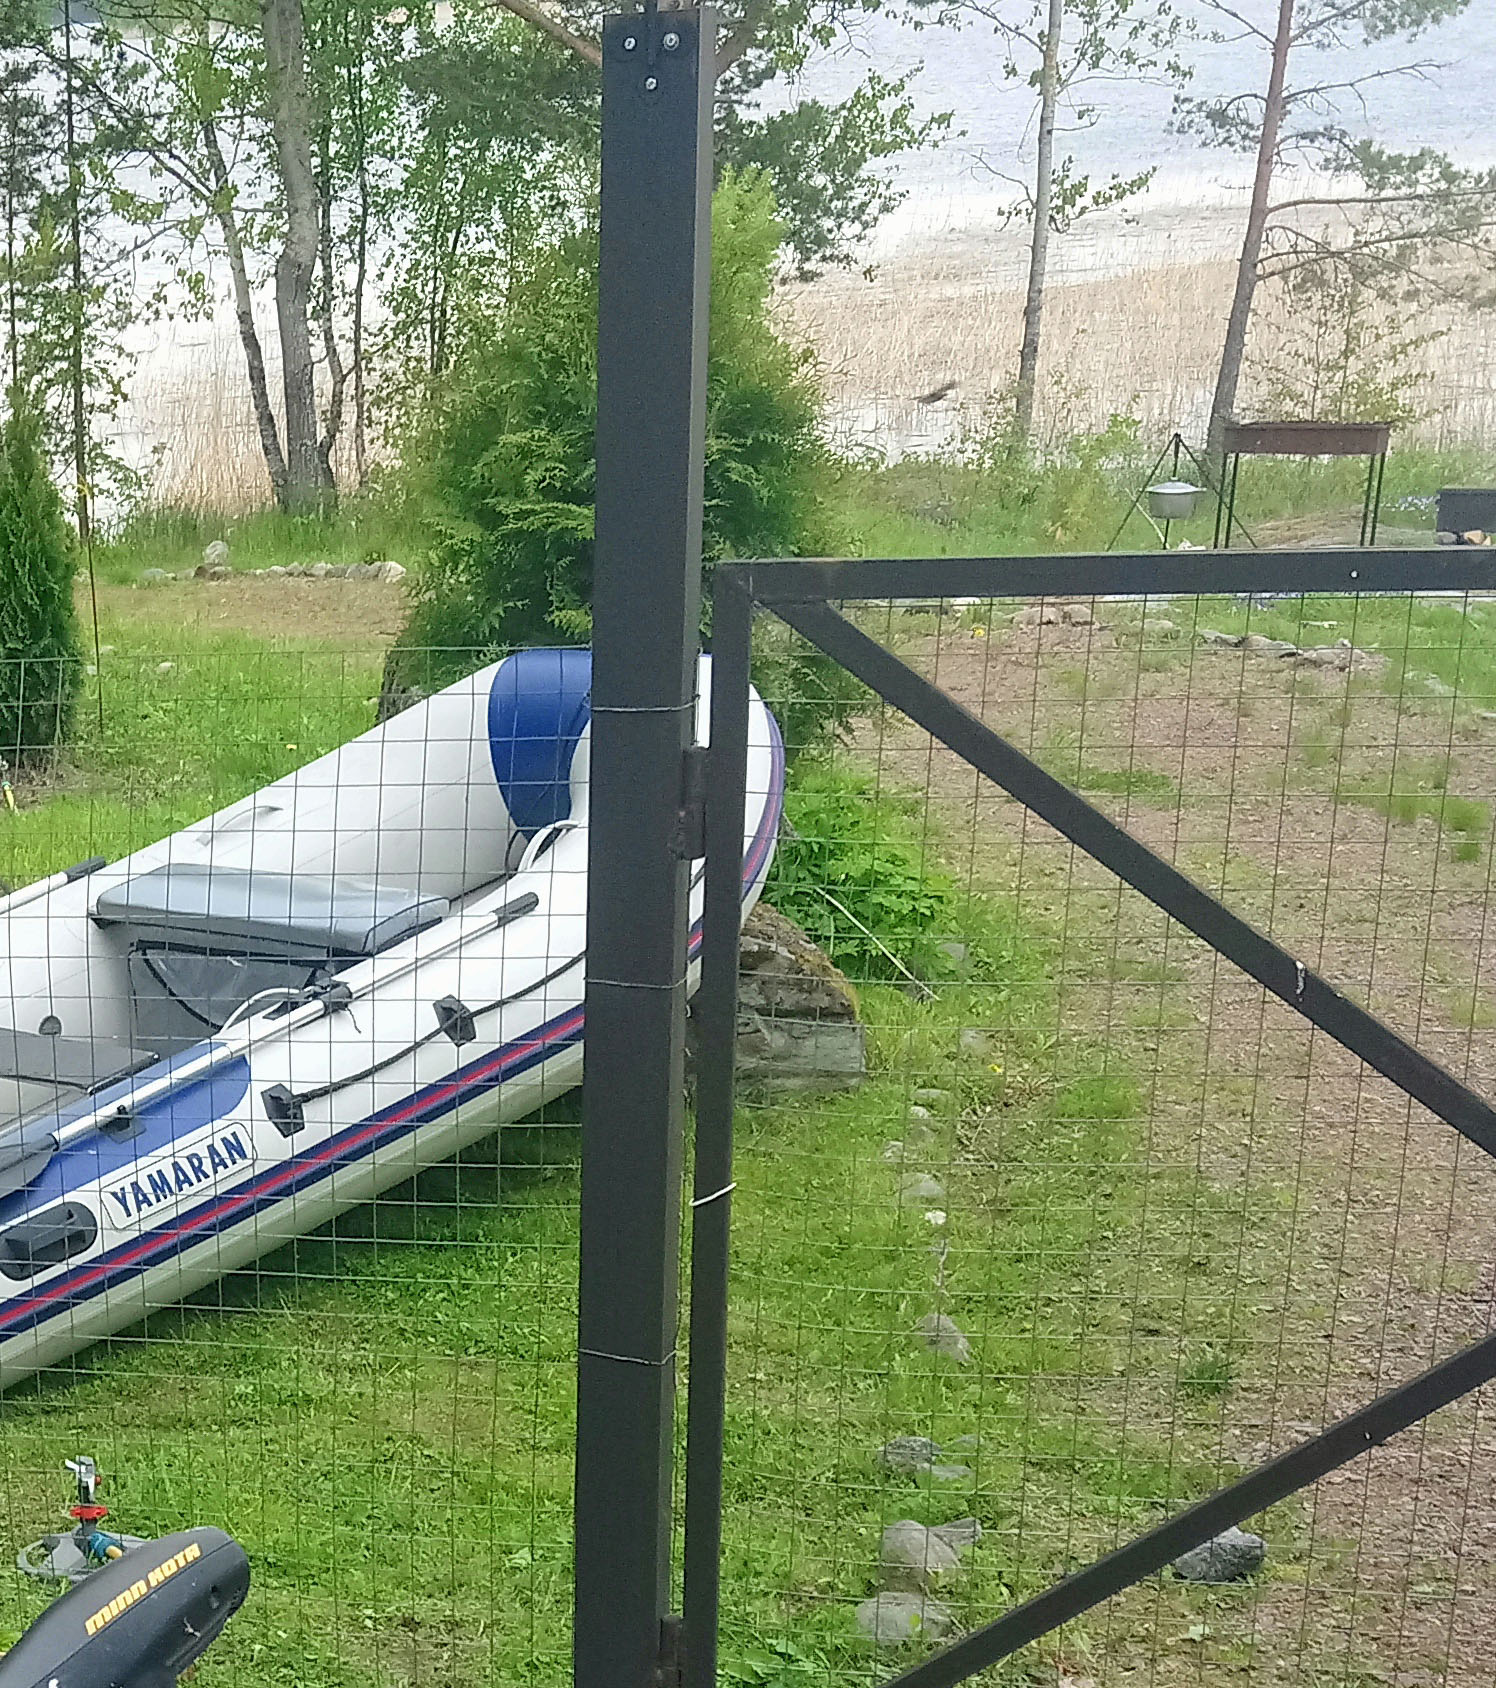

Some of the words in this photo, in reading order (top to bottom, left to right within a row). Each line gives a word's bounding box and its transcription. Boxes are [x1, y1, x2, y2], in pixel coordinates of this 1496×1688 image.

[110, 1131, 250, 1219] YAMARAN
[84, 1579, 147, 1636] MINN
[147, 1543, 202, 1588] KOTA
